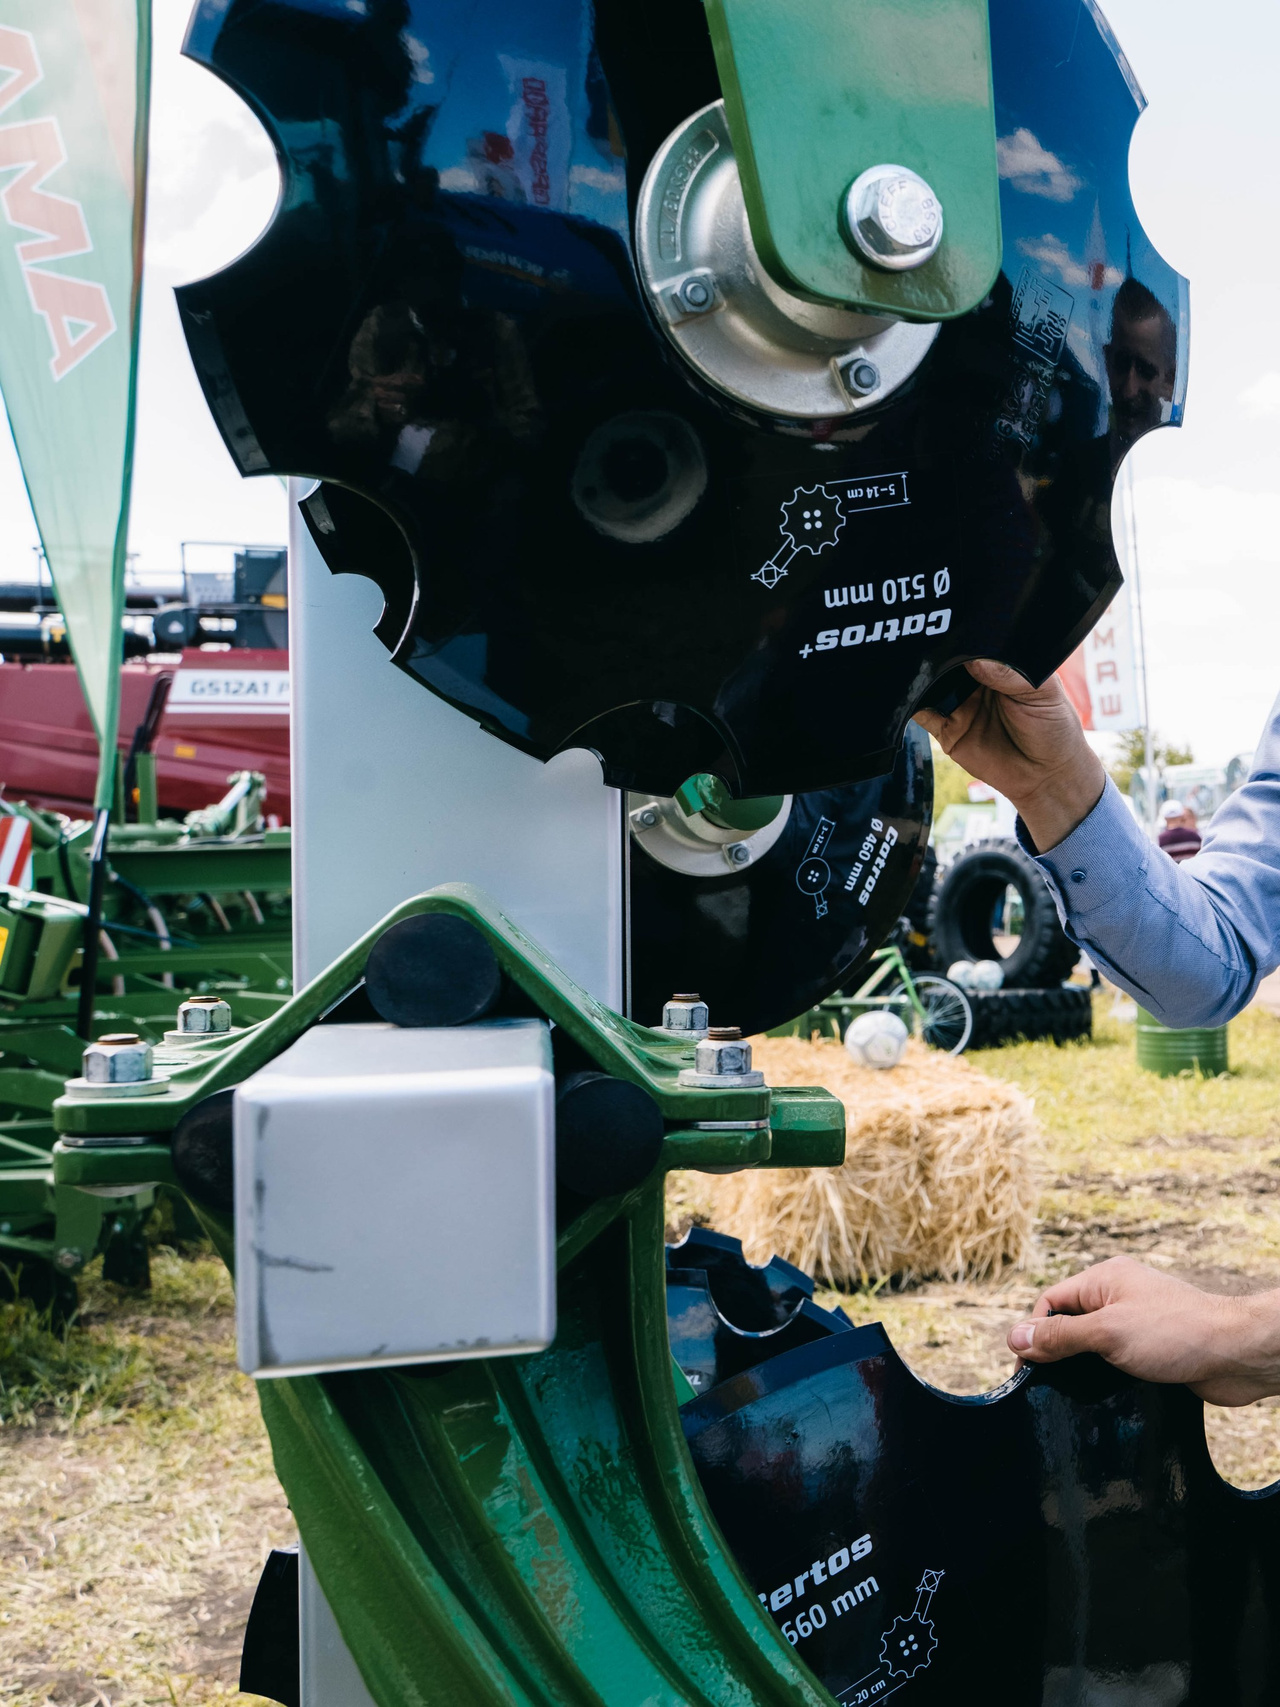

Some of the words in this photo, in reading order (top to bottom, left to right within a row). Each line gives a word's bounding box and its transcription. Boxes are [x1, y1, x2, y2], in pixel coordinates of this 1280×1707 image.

[847, 488, 864, 499] cm
[824, 583, 874, 609] mm
[882, 574, 925, 605] 510
[190, 681, 269, 696] GS12A1
[858, 833, 878, 861] 460
[844, 862, 864, 892] mm
[858, 826, 899, 906] Catros
[780, 1604, 827, 1647] 660
[831, 1576, 880, 1617] mm
[870, 1679, 887, 1694] cm
